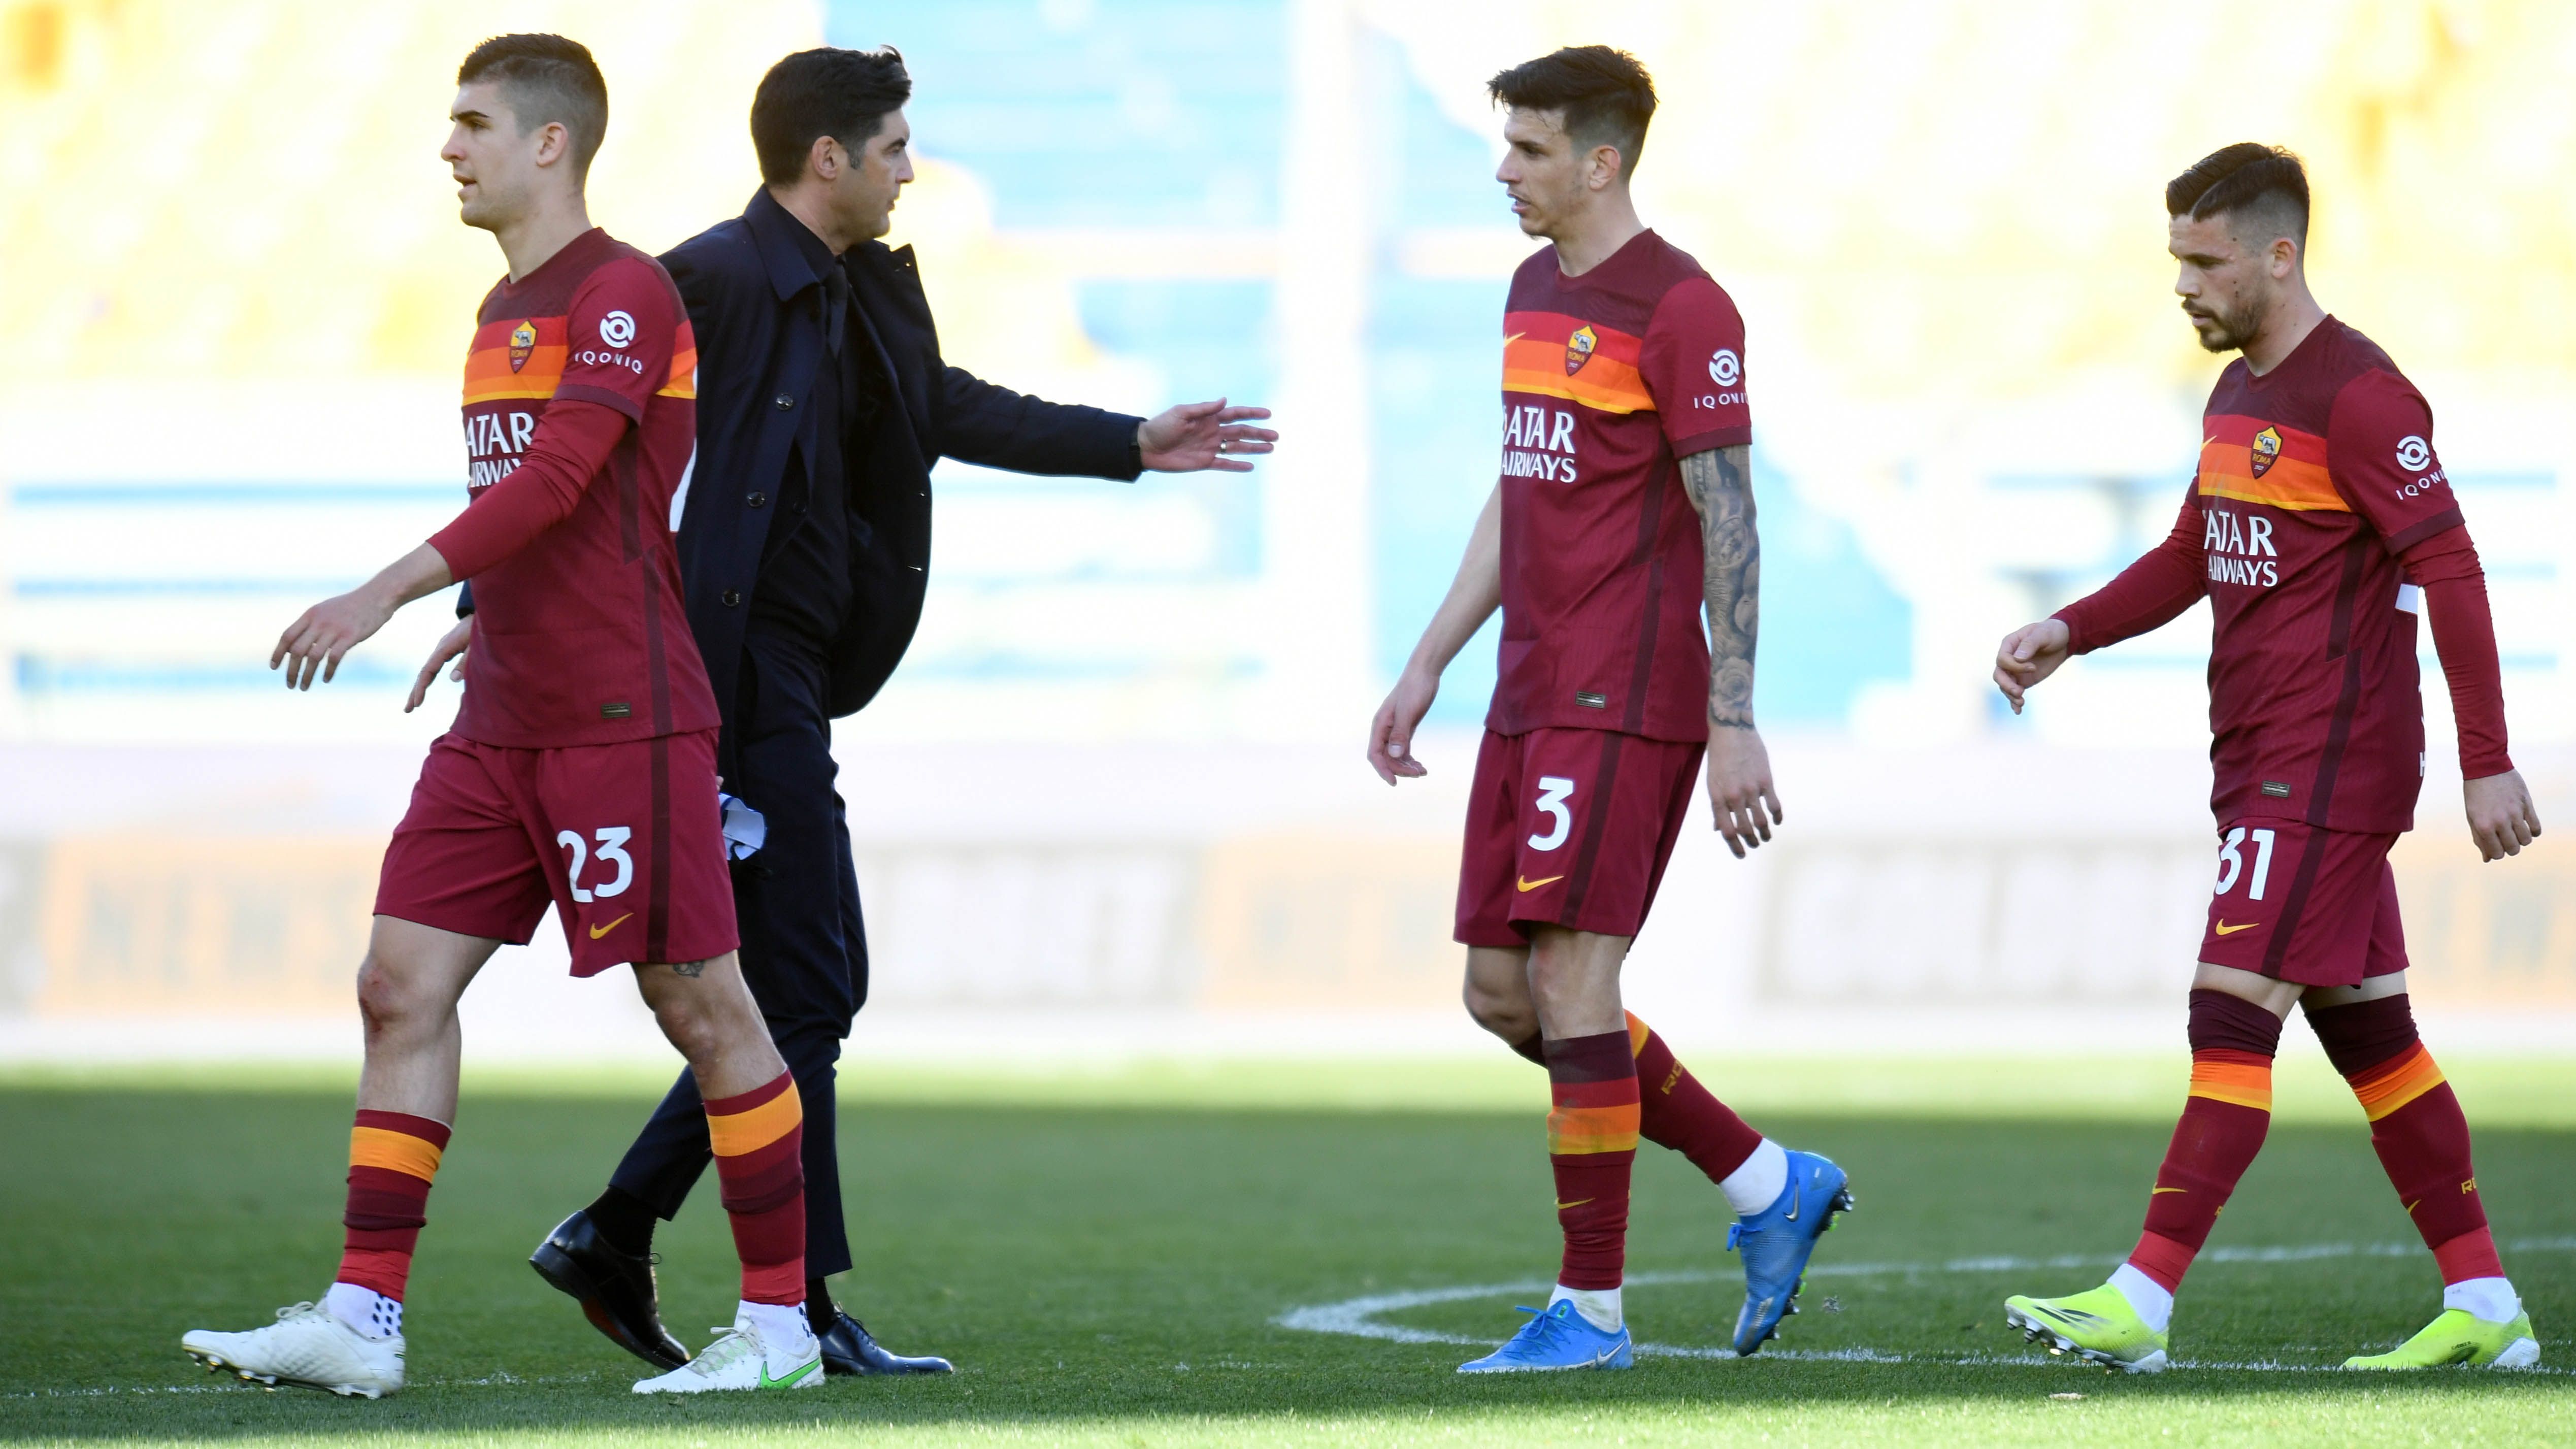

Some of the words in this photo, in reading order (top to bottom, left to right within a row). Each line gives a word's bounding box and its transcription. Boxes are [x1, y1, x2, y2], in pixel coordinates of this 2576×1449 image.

[575, 351, 642, 374] IQONIQ
[466, 412, 534, 457] ATAR
[1504, 406, 1575, 454] ATAR
[1500, 451, 1576, 483] AIRWAYS
[2396, 469, 2446, 500] IQONI
[2202, 509, 2277, 557] ATAR
[2208, 555, 2278, 587] AIRWAYS
[1527, 777, 1574, 851] 3
[557, 826, 633, 903] 23
[2215, 827, 2275, 901] 31
[1661, 1060, 1684, 1095] RO
